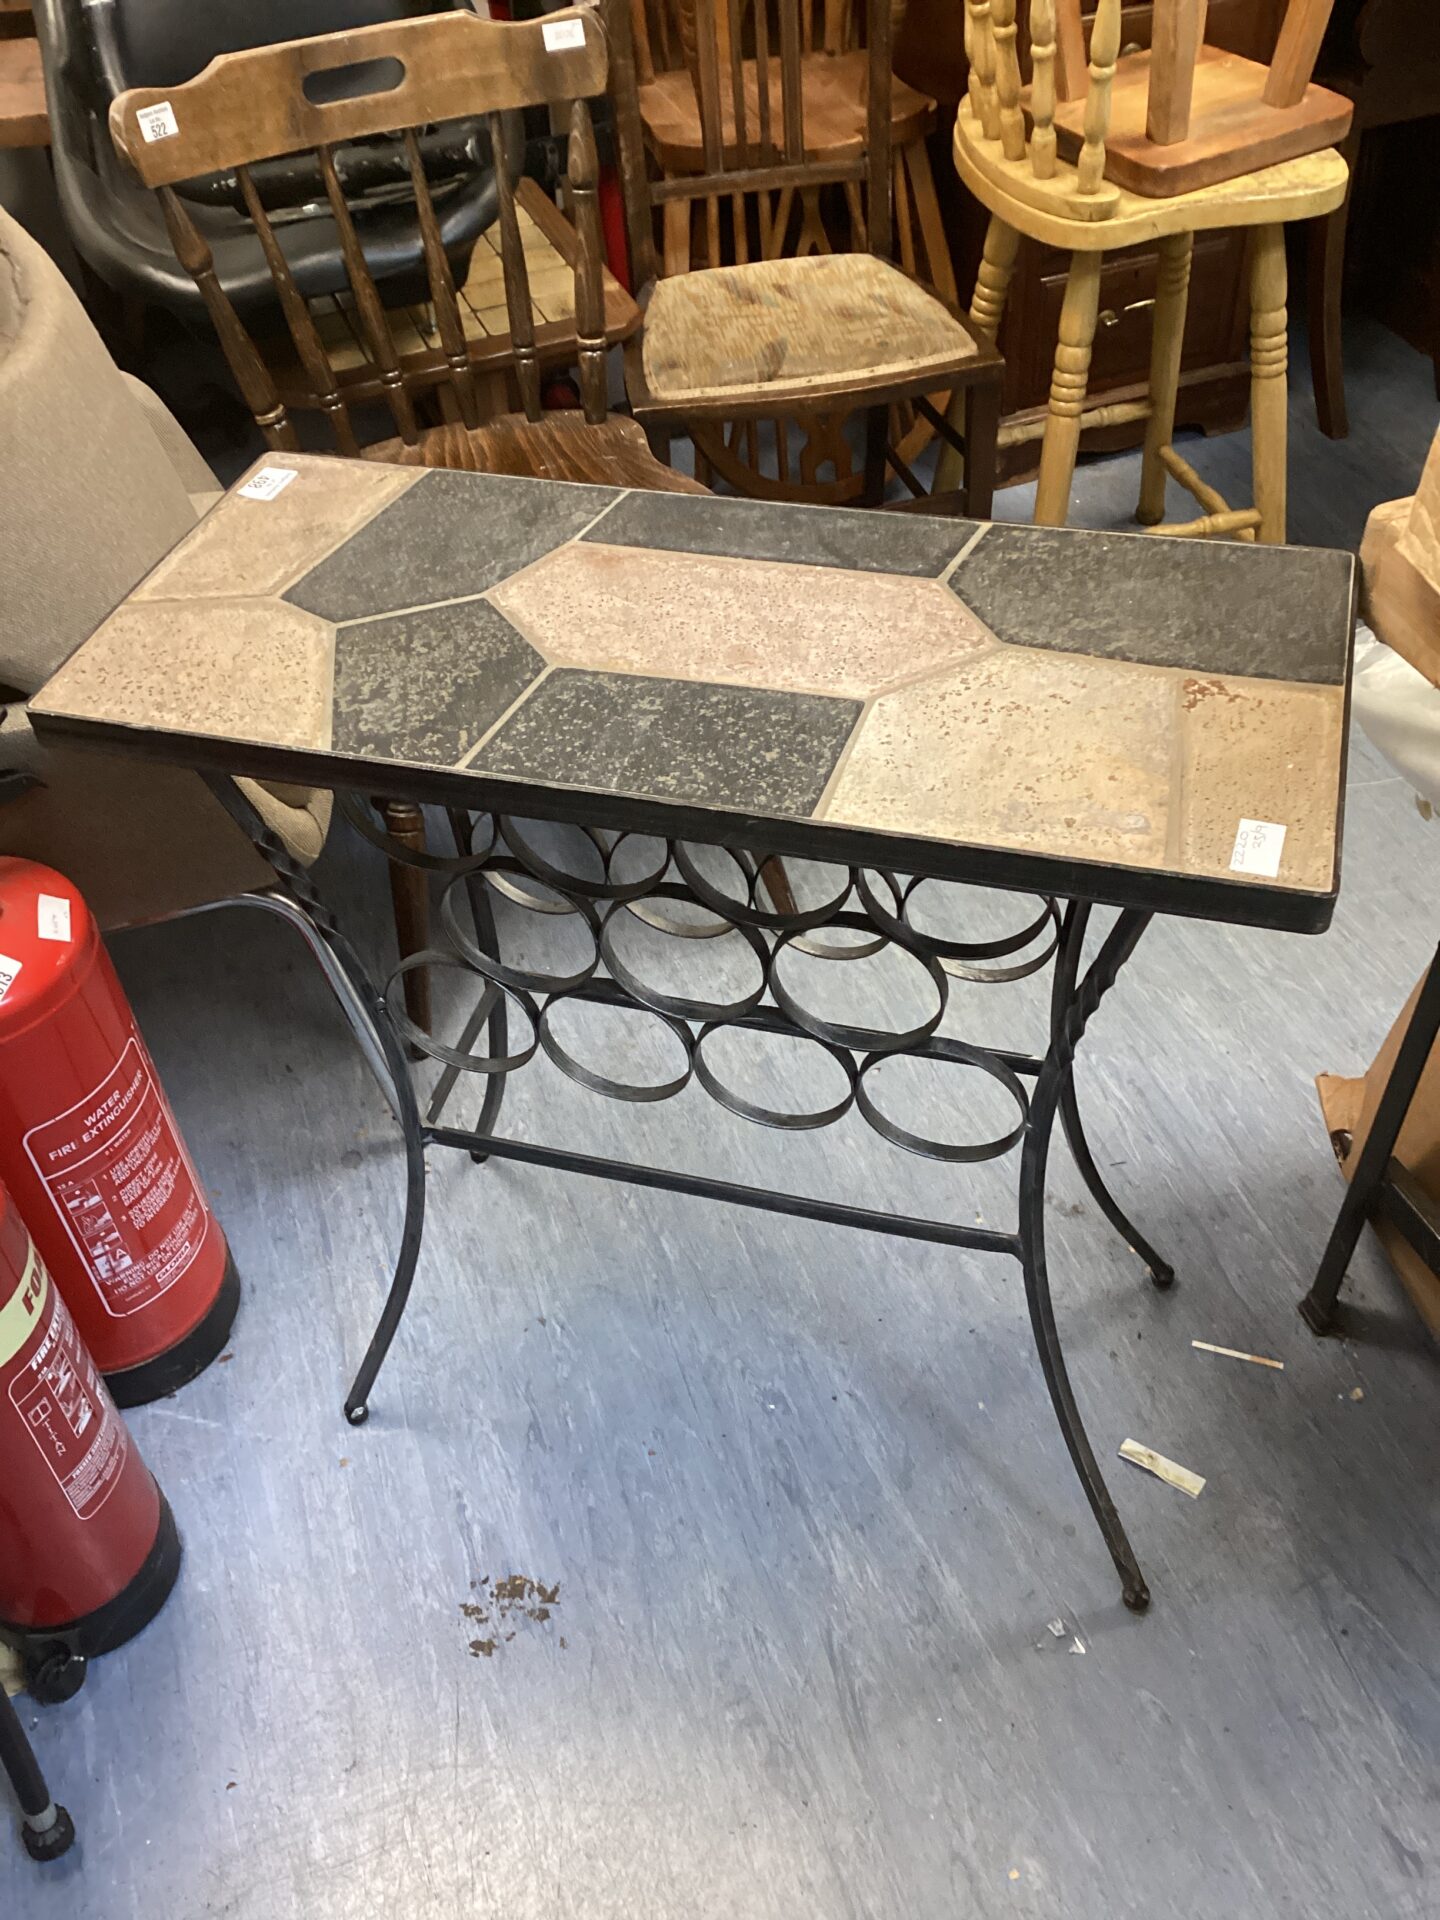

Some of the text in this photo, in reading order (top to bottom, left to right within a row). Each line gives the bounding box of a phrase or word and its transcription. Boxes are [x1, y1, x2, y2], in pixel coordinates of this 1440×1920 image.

[150, 122, 168, 138] 522
[1233, 831, 1249, 865] 2220
[81, 1068, 143, 1143] EXTINGUISHER
[83, 1090, 121, 1127] WATER
[114, 1129, 132, 1148] WATER
[119, 1172, 143, 1196] DIRECT
[136, 1221, 146, 1231] TO
[148, 1249, 160, 1260] DO
[159, 1235, 173, 1250] NOT
[157, 1243, 189, 1281] GLORIA
[129, 1274, 146, 1288] NOT
[147, 1261, 161, 1275] USE
[161, 1251, 173, 1263] ON
[31, 1339, 53, 1371] FIRE
